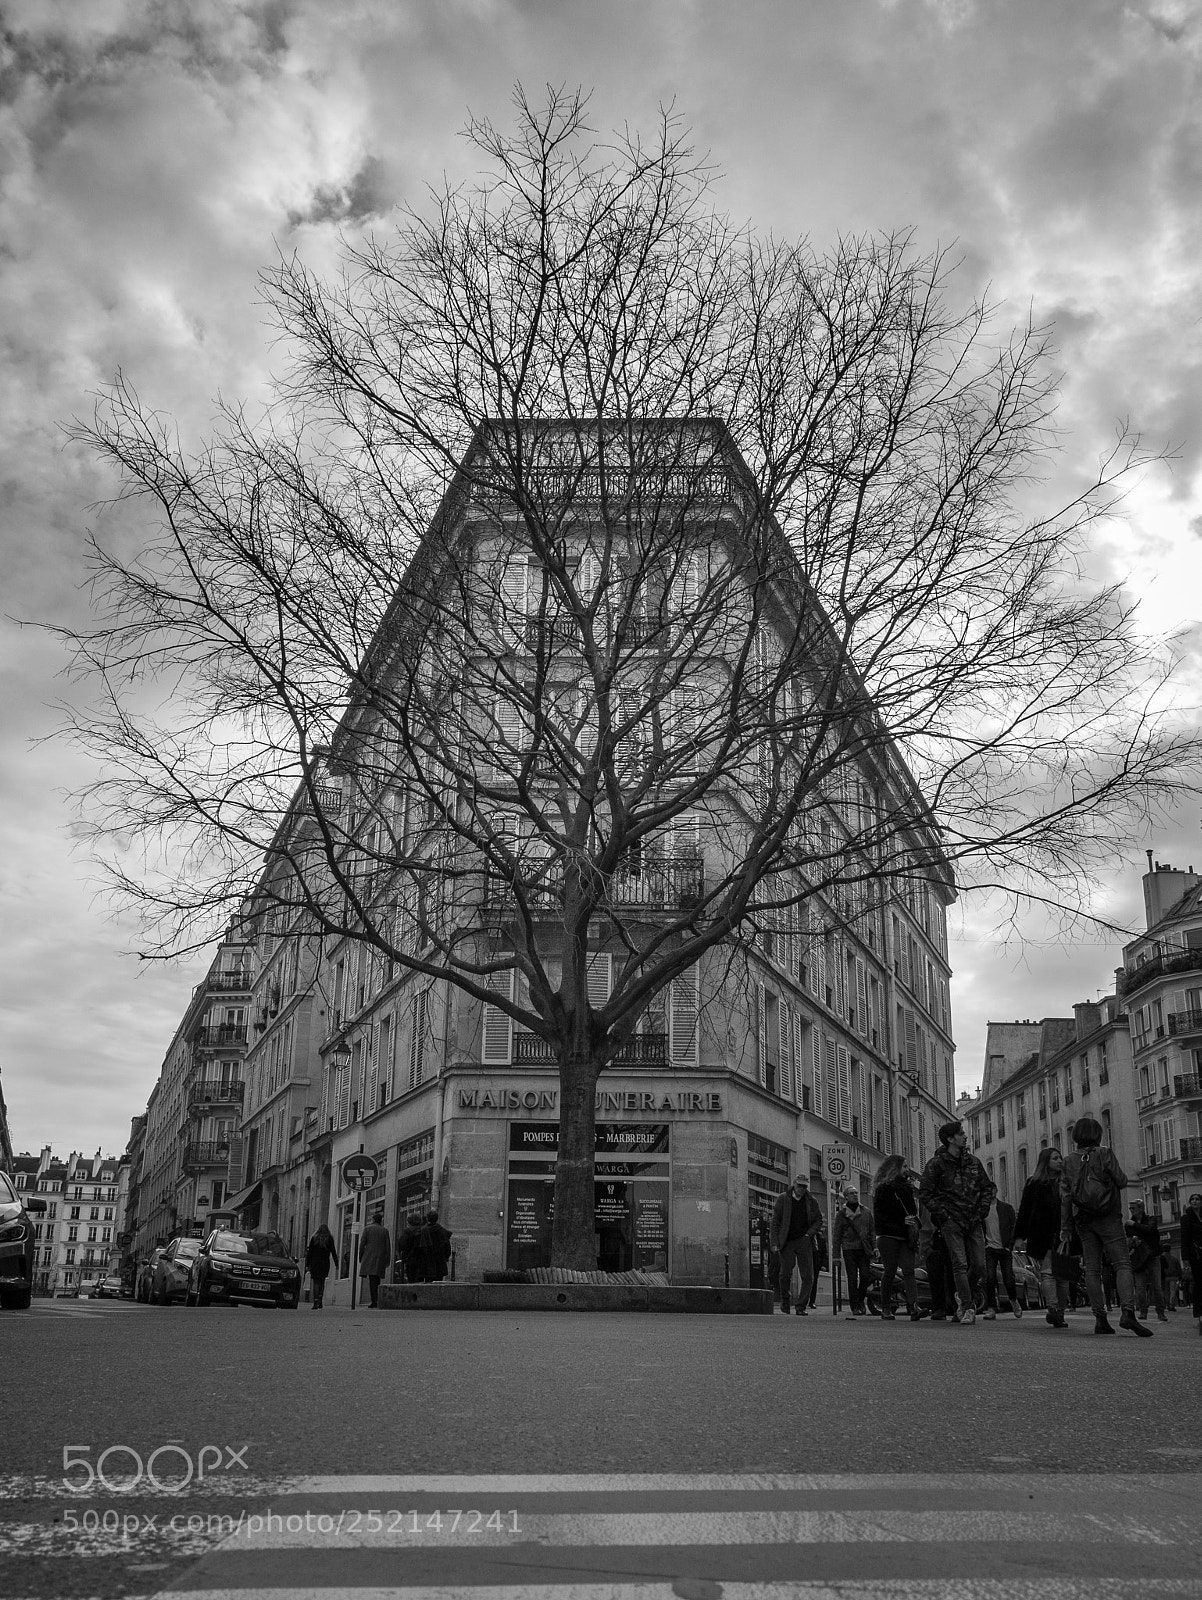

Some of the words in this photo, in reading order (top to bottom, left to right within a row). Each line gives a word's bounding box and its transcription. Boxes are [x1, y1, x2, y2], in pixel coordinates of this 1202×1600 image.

[459, 1090, 556, 1109] MAISON
[594, 1092, 723, 1112] UNERAIRE
[523, 1132, 554, 1142] POMPES
[606, 1133, 655, 1144] MARBRERIE
[850, 1144, 872, 1173] ARGA
[596, 1165, 630, 1173] WARGA
[831, 1163, 842, 1171] 30
